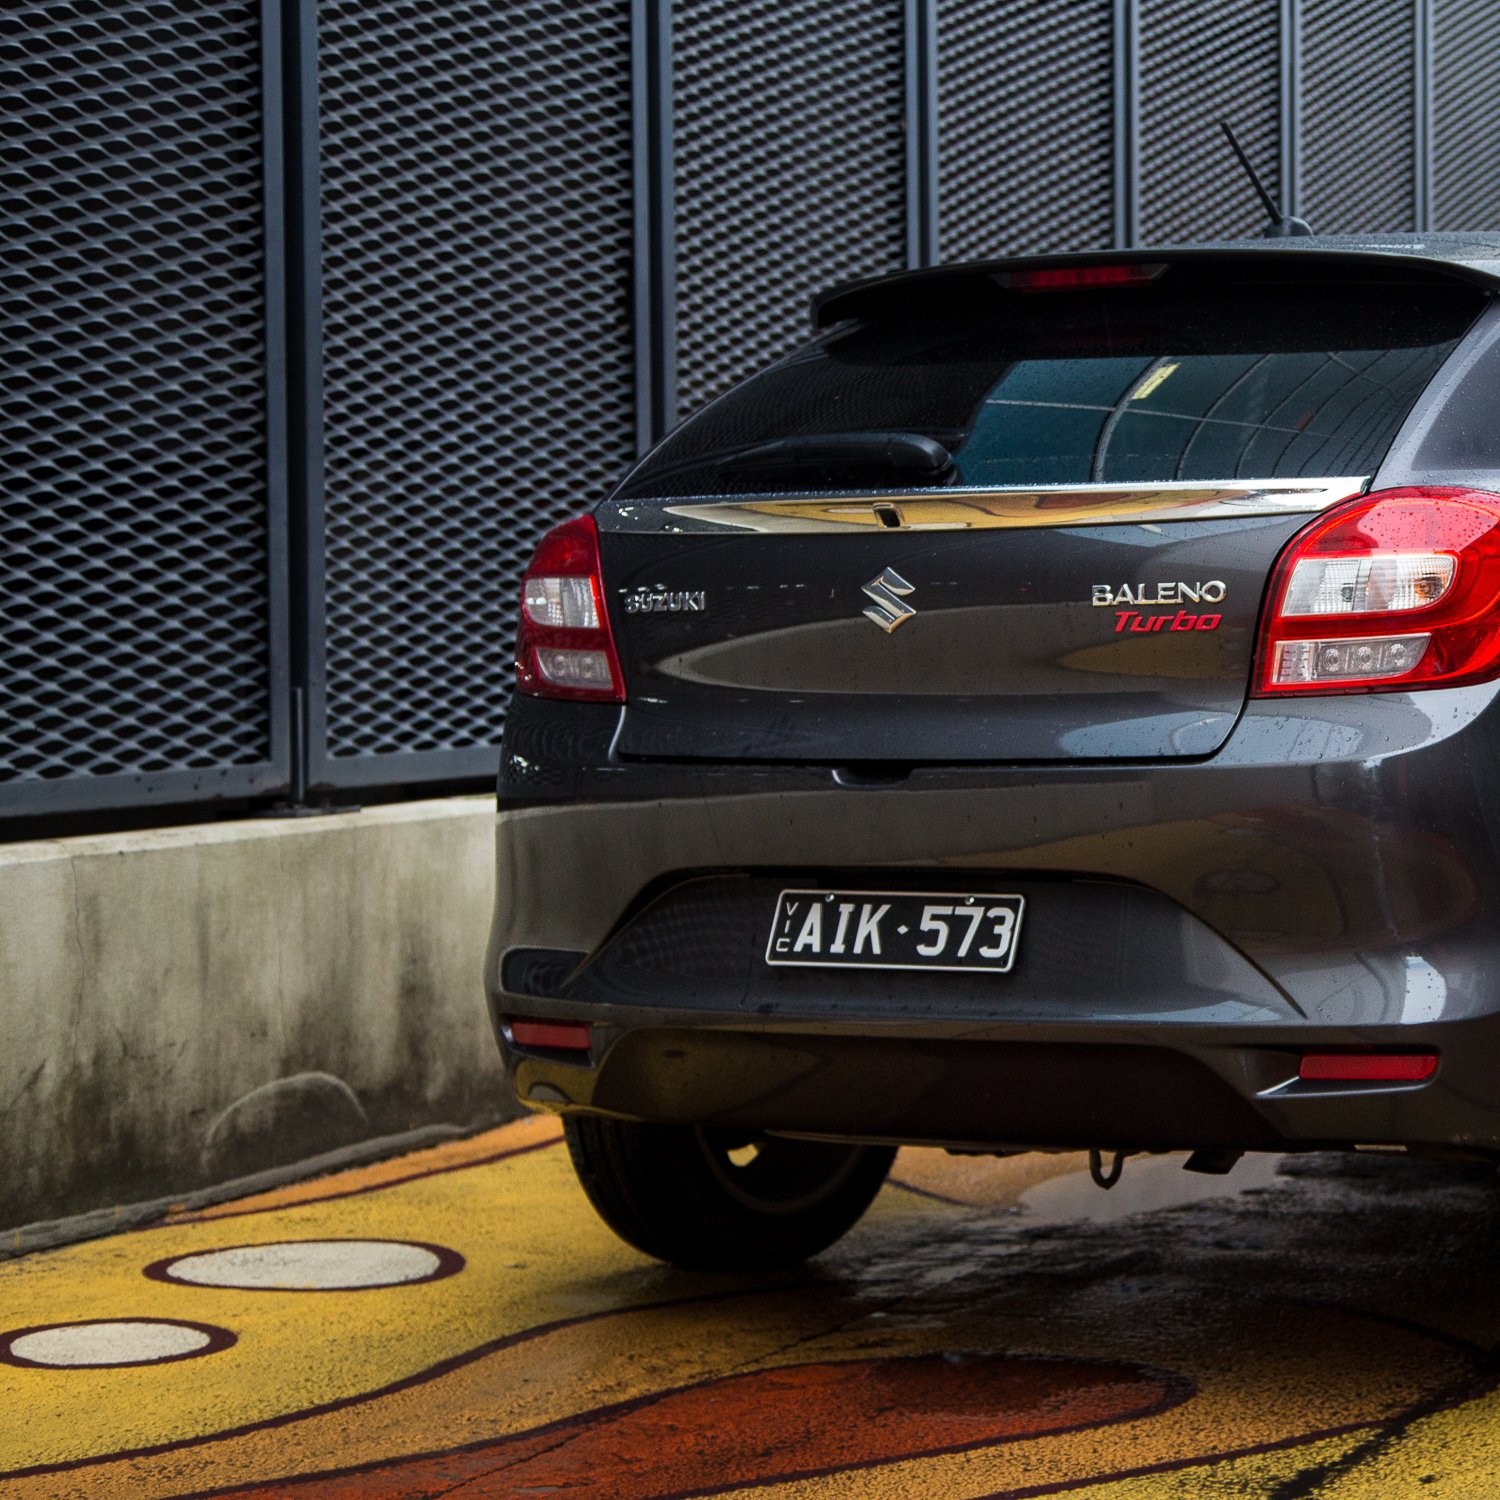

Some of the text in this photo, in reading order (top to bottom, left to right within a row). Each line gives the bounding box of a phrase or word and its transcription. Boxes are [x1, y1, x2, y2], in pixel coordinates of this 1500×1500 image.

[624, 591, 706, 613] SUZUKI
[1091, 580, 1228, 607] BALENO
[1113, 610, 1223, 633] Turbo
[775, 901, 799, 952] VIC
